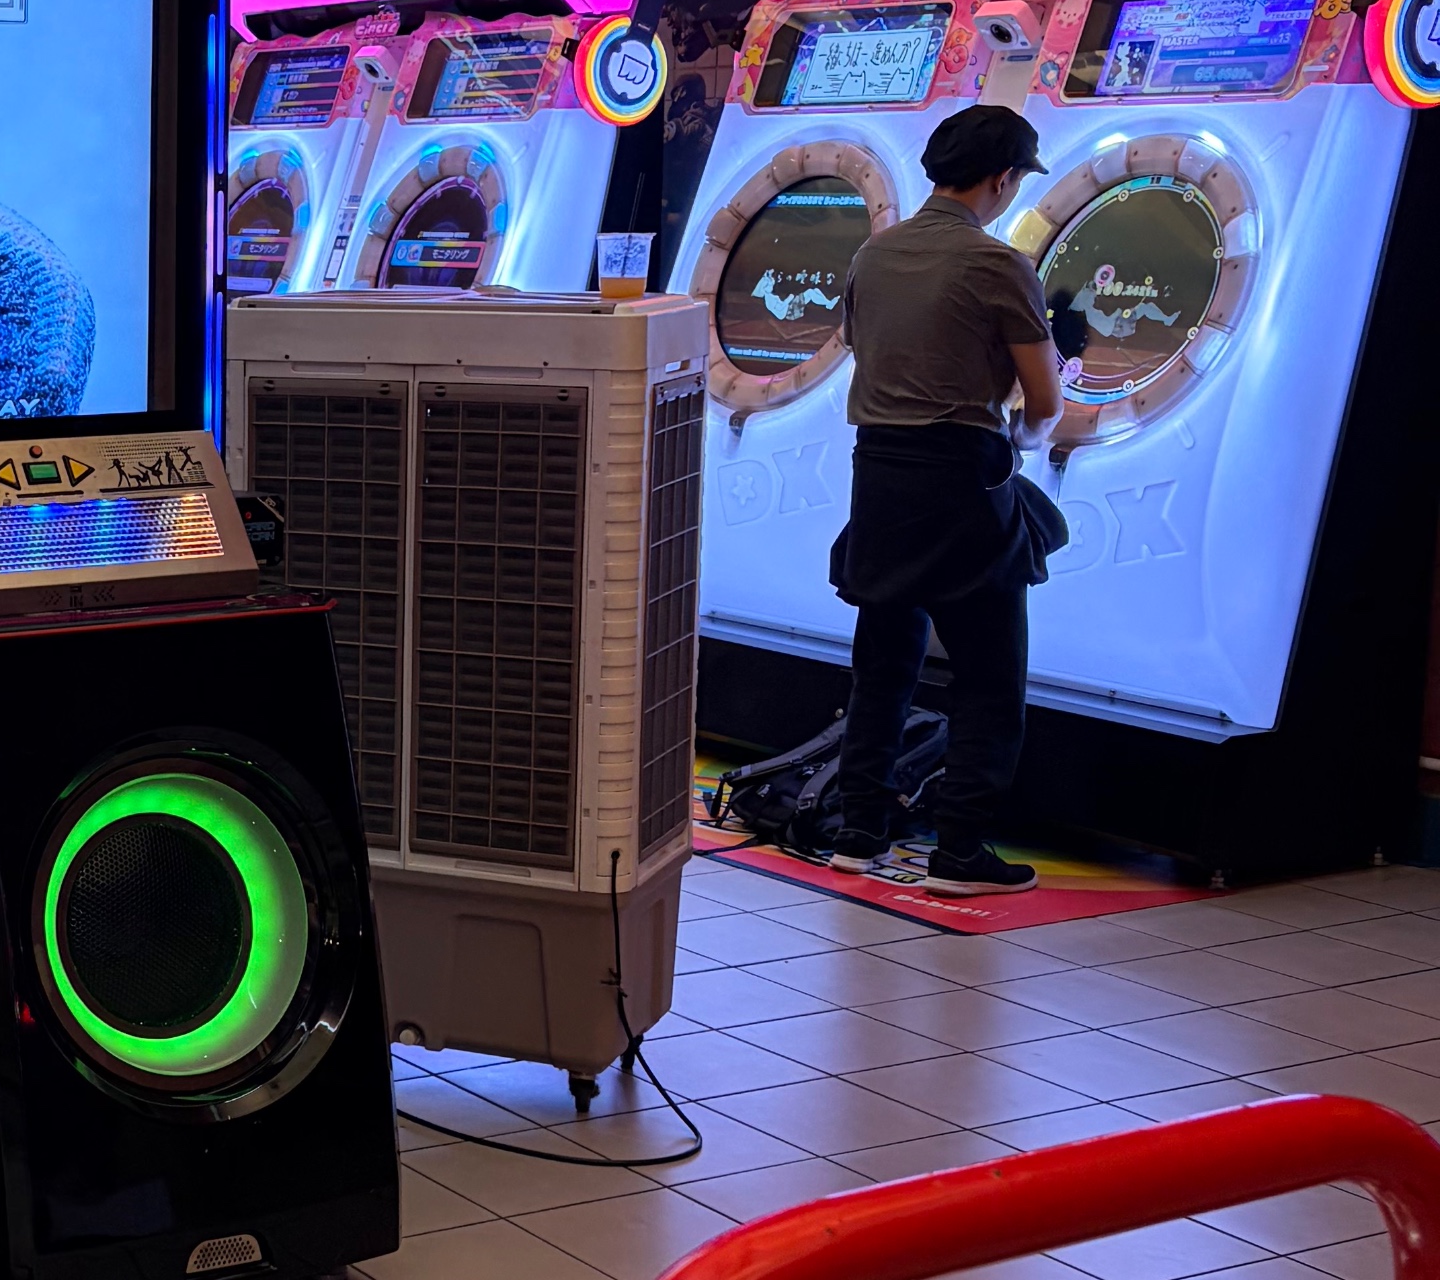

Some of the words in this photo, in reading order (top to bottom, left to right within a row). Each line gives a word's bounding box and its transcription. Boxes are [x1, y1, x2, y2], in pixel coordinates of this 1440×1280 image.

[248, 243, 279, 255] モニタリング
[431, 248, 469, 260] モニタリング
